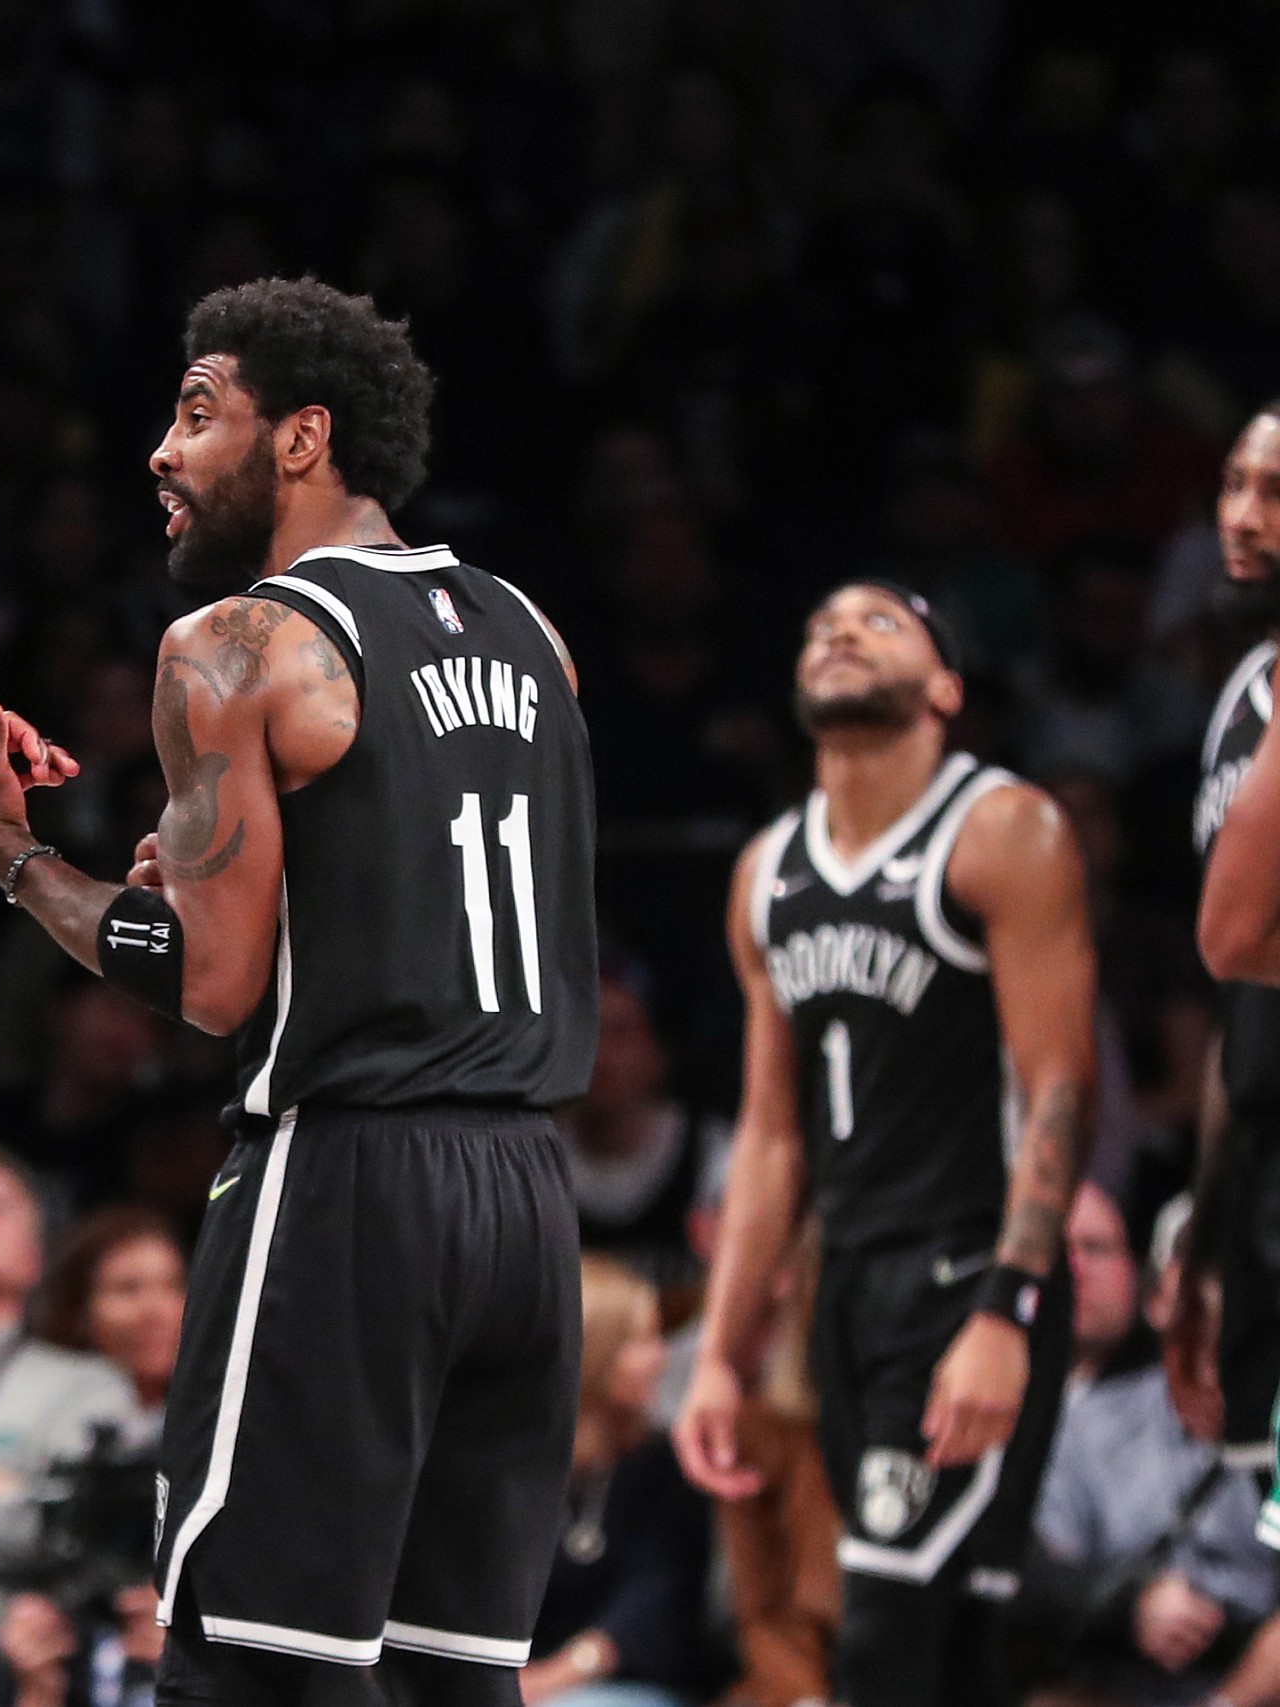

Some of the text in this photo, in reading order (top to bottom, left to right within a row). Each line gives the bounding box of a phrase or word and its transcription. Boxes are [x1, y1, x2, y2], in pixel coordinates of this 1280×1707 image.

[410, 656, 538, 743] IRVING
[106, 919, 151, 950] 11
[148, 922, 171, 954] KAI
[451, 792, 542, 1015] 11
[766, 920, 938, 1018] ROOKLYN
[821, 1018, 854, 1142] 1
